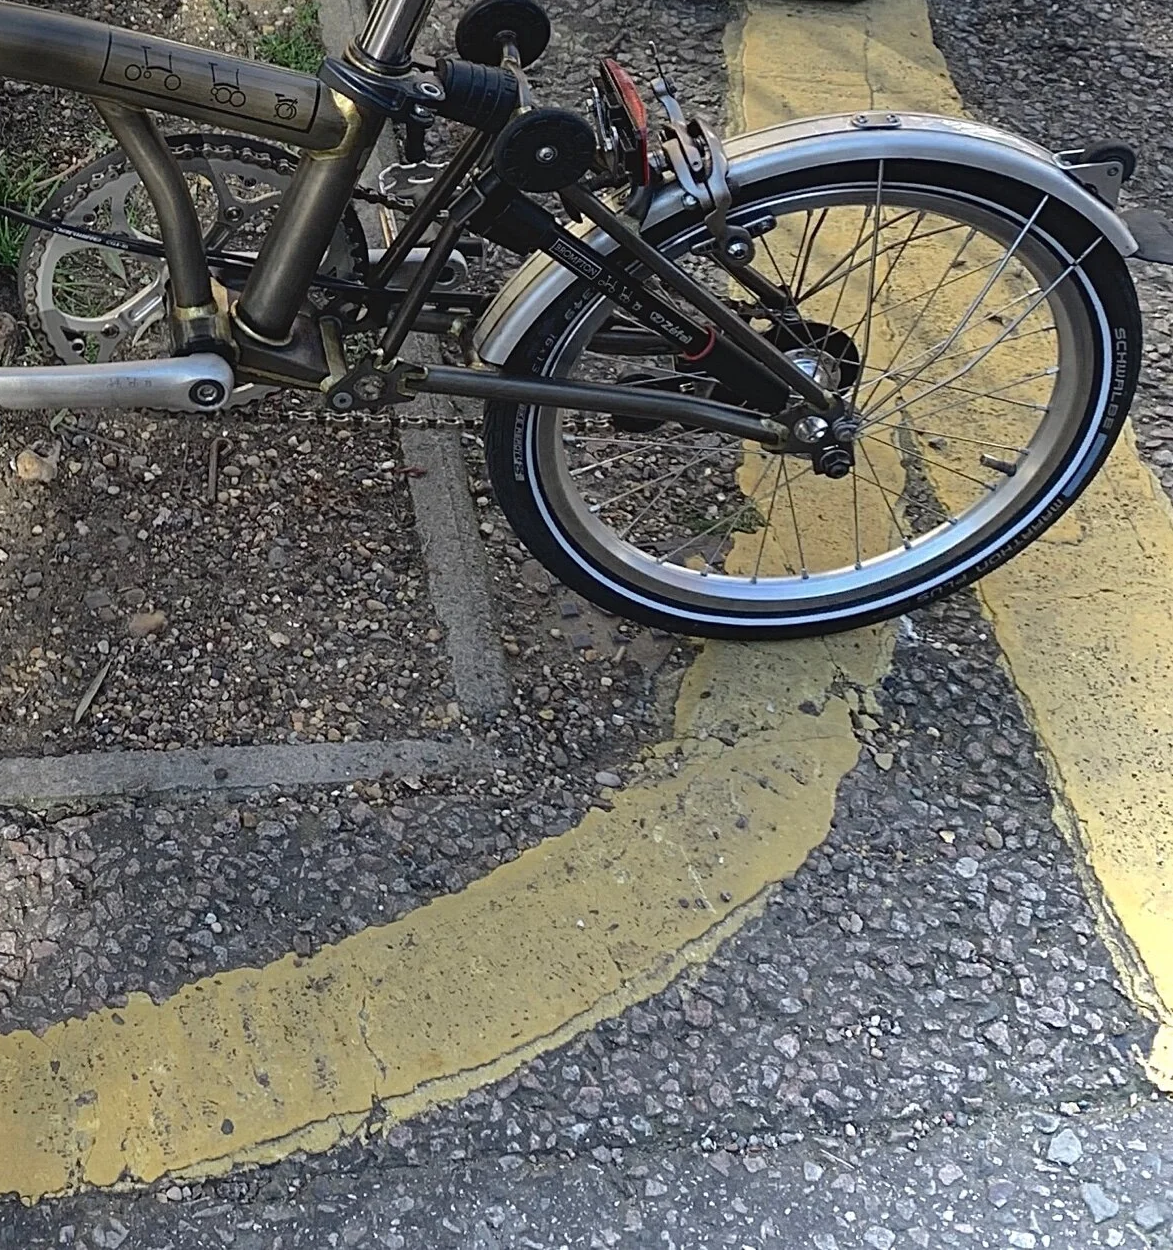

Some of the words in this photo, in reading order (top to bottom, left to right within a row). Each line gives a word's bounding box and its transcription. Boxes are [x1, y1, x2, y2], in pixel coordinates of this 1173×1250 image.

[554, 242, 599, 277] BROMPTON
[563, 286, 595, 322] 349
[1102, 326, 1128, 431] SCHWALBE
[977, 493, 1065, 574] MARATHON
[915, 574, 969, 601] PLUS
